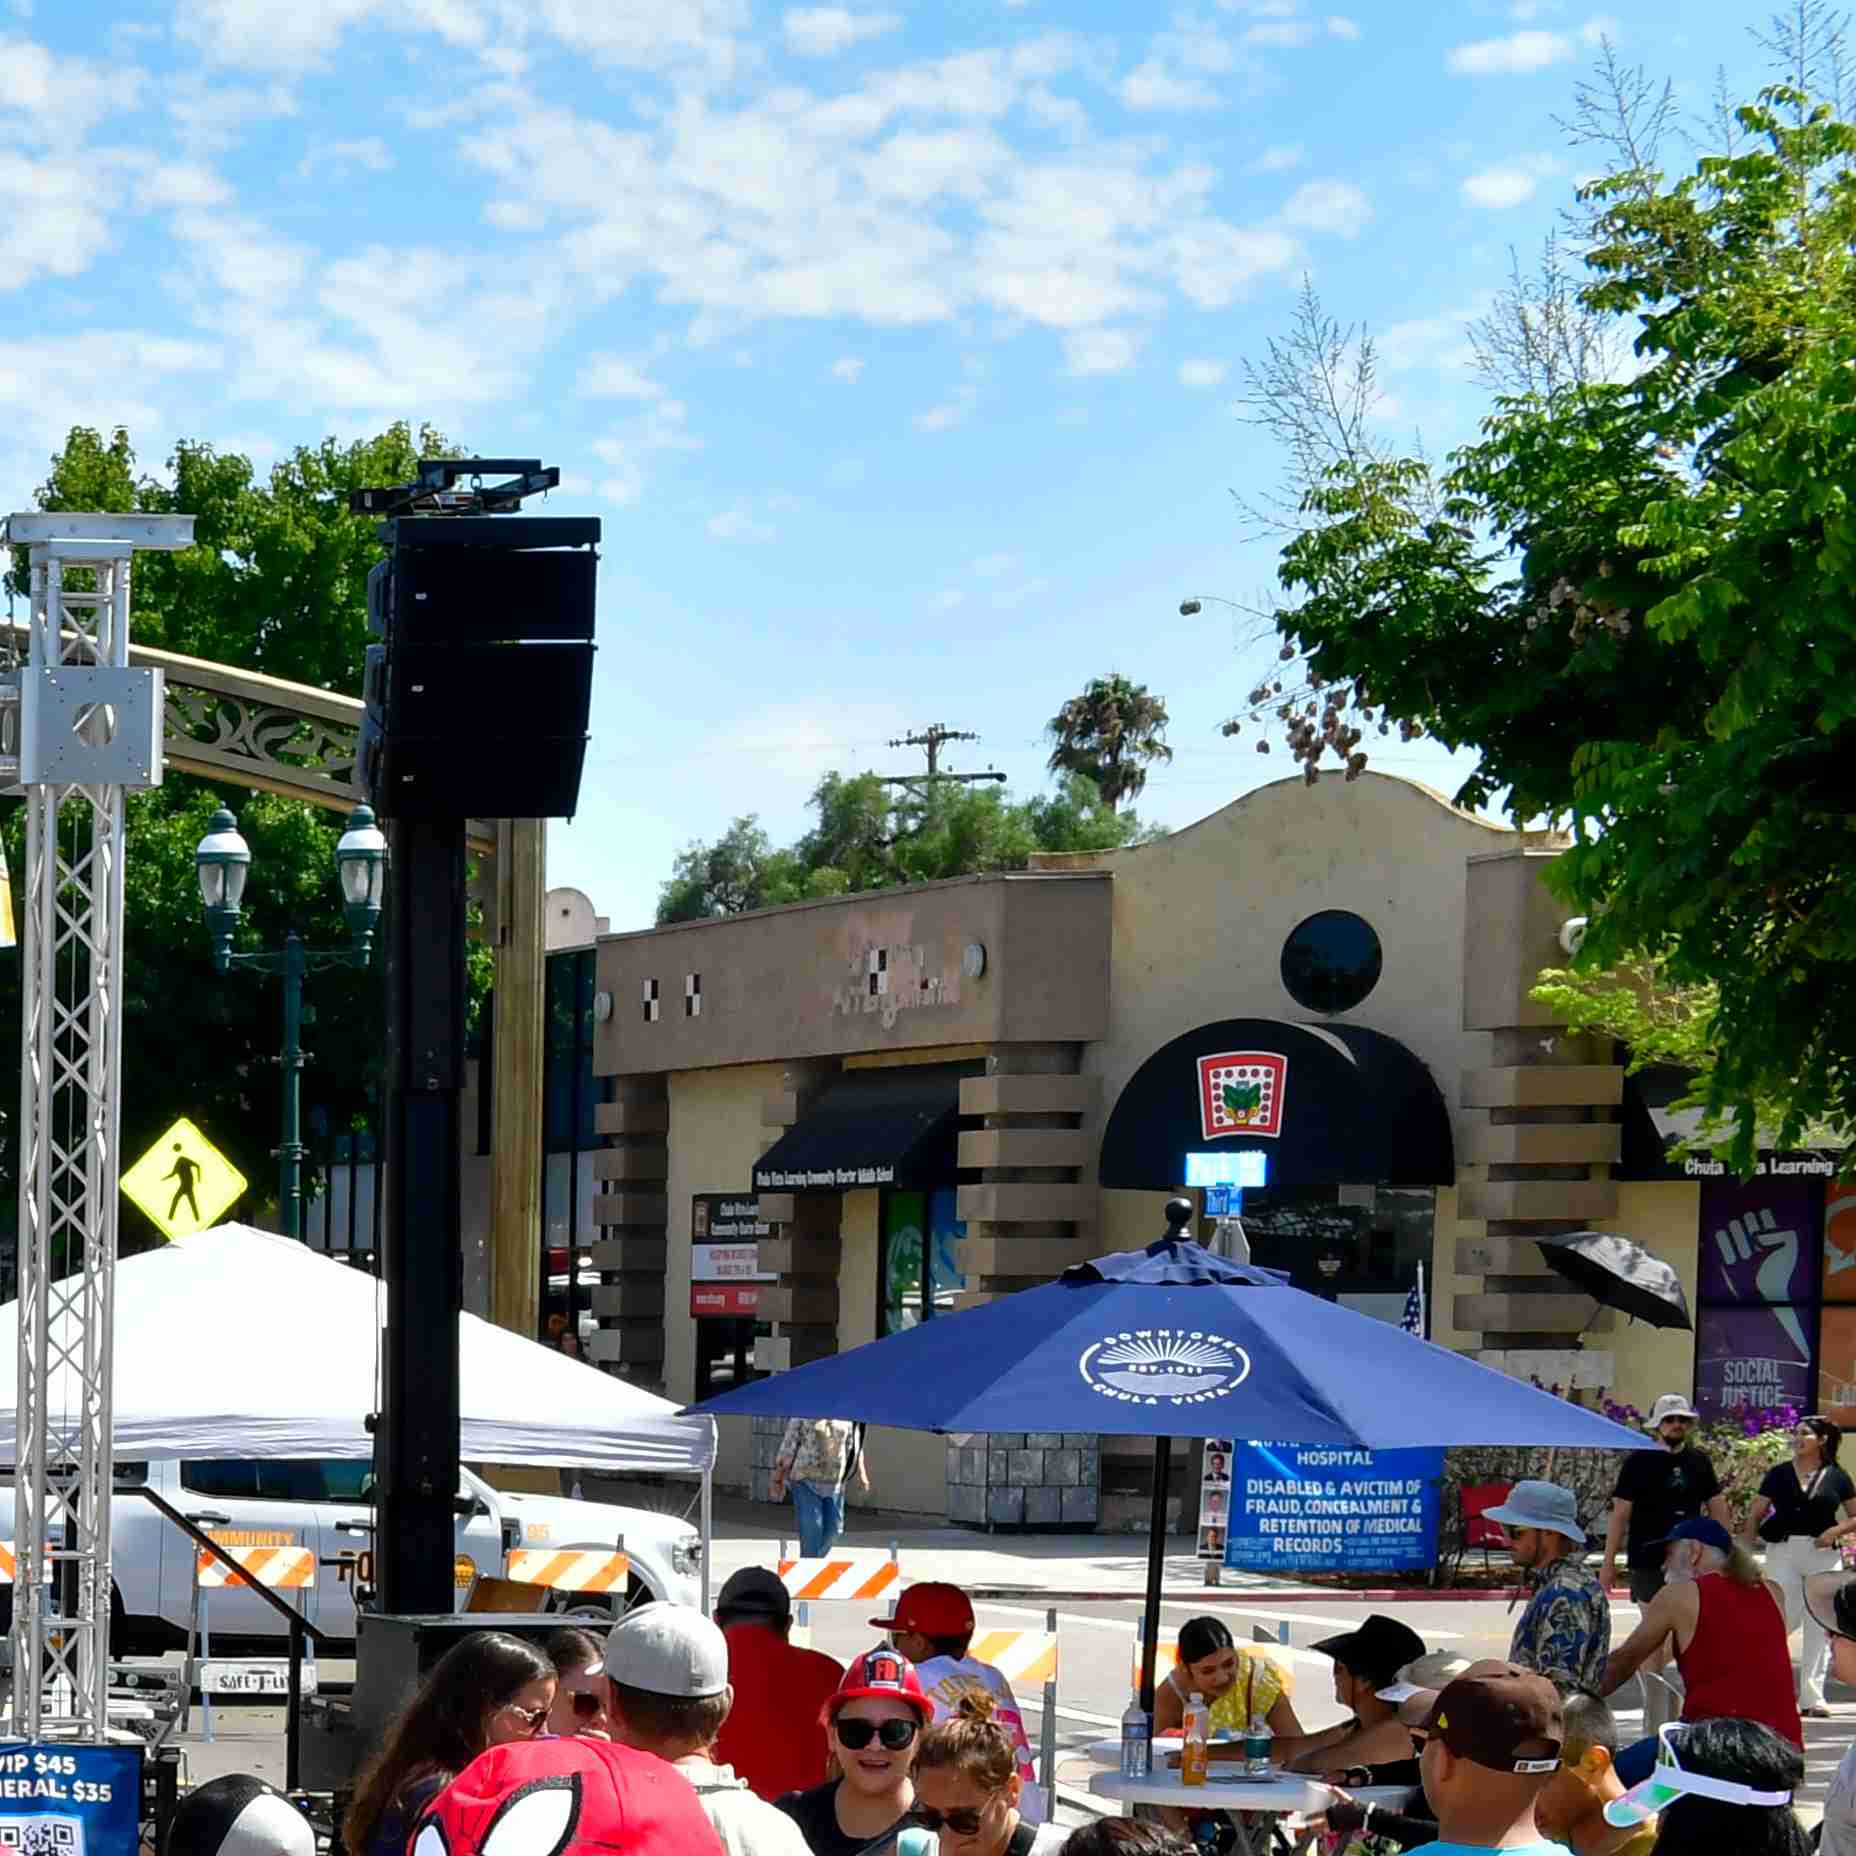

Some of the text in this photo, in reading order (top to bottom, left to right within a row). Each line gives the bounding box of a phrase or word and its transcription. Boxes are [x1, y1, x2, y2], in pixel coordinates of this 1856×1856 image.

[1685, 1158, 1725, 1175] Chula
[1770, 1157, 1834, 1177] Learning
[1104, 1329, 1236, 1349] DOWNTOWN
[1723, 1359, 1783, 1383] SOCIAL
[1092, 1383, 1230, 1405] CHULA VISTA
[1720, 1385, 1785, 1408] JUSTICE
[1296, 1451, 1374, 1466] HOSPITAL
[1246, 1479, 1323, 1496] DISABLED
[1325, 1481, 1336, 1496] &
[1407, 1479, 1422, 1493] OF
[1245, 1499, 1422, 1517] FRAUD, CONCEALMENT &
[1259, 1518, 1423, 1534] RETENTION OF MEDICAL
[1273, 1537, 1343, 1553] RECORDS
[34, 1754, 76, 1776] $45
[72, 1778, 113, 1803] $35
